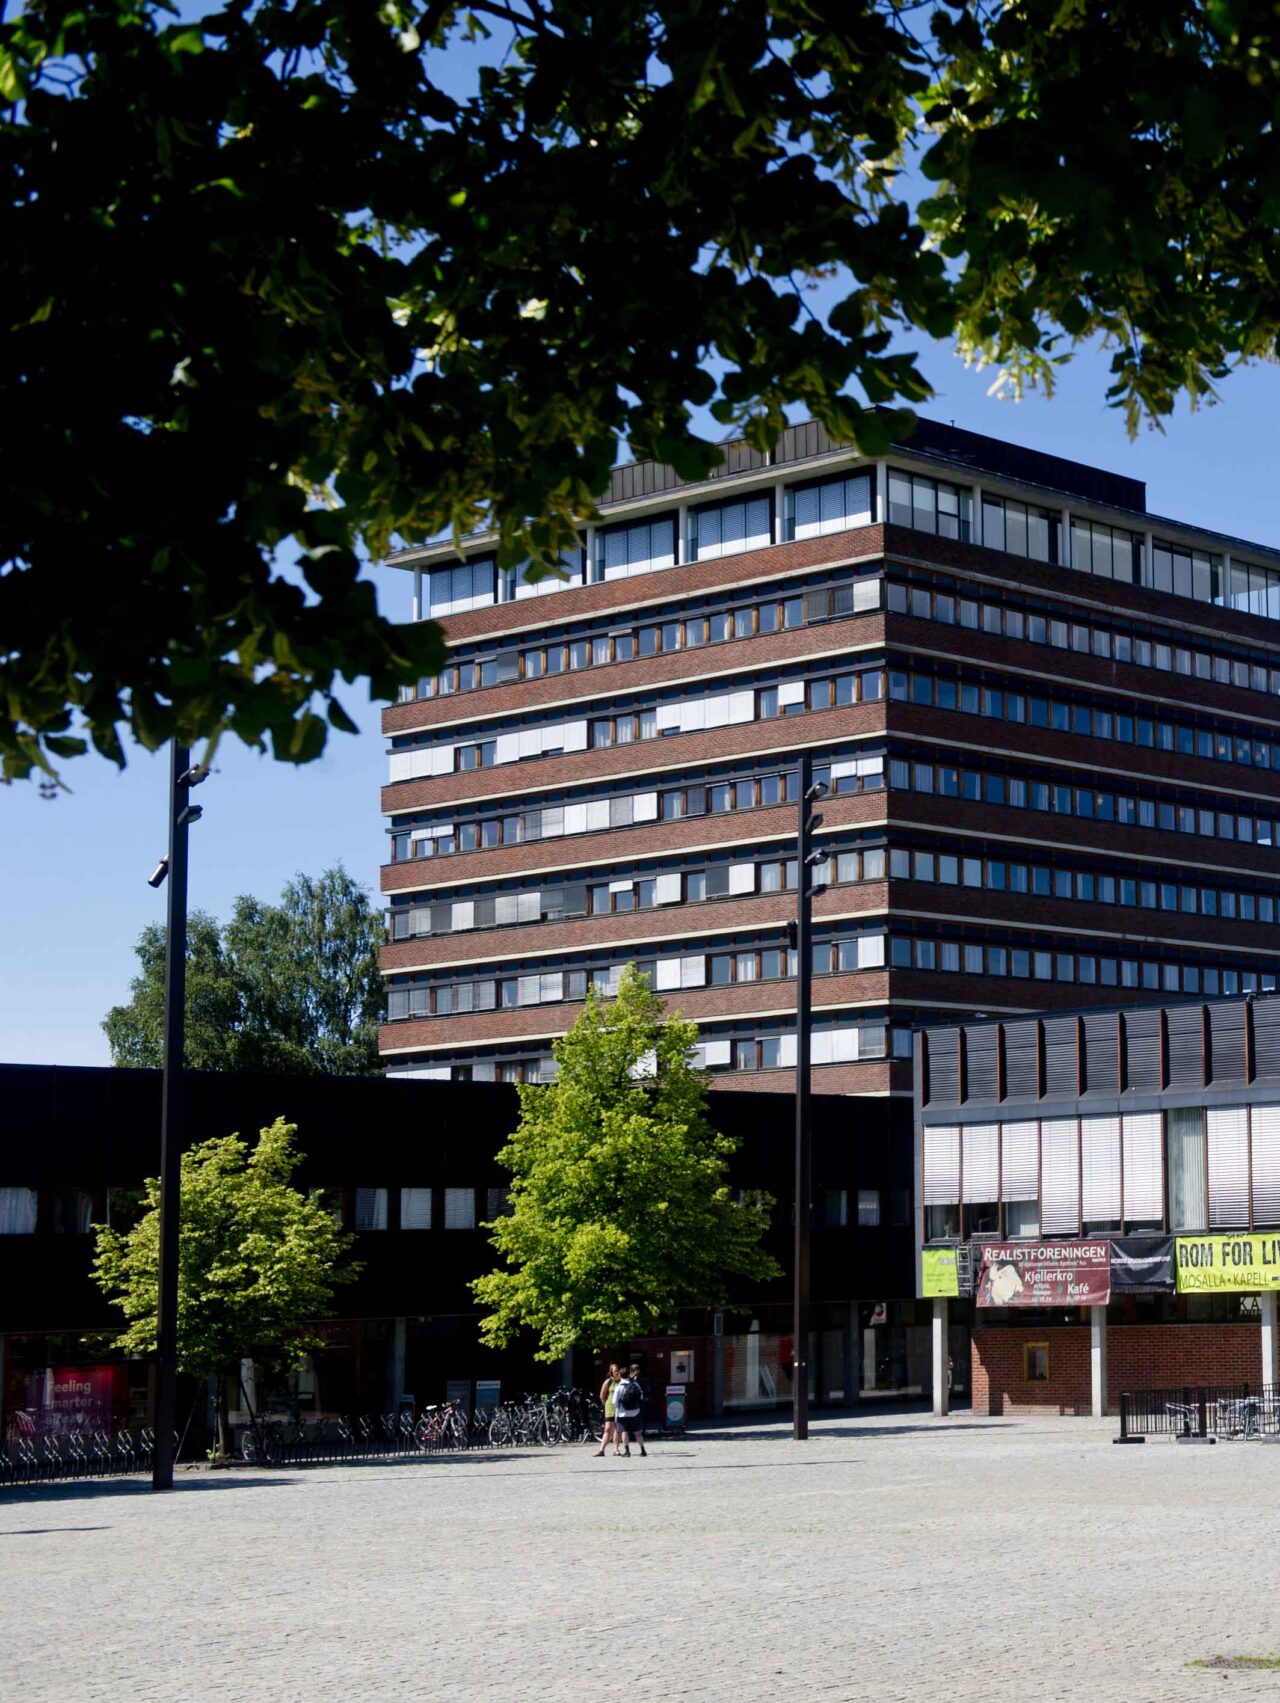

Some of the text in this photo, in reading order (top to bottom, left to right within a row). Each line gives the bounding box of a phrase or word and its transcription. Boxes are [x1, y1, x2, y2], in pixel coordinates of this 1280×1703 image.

[984, 1246, 1105, 1261] REALISTFORENINGEN
[1179, 1243, 1213, 1268] ROM
[1222, 1241, 1253, 1267] FOR
[1024, 1270, 1073, 1285] Kjellerkro
[1180, 1273, 1227, 1289] MOSALLA
[1233, 1272, 1270, 1287] KAPELL
[1067, 1283, 1090, 1295] Kafé
